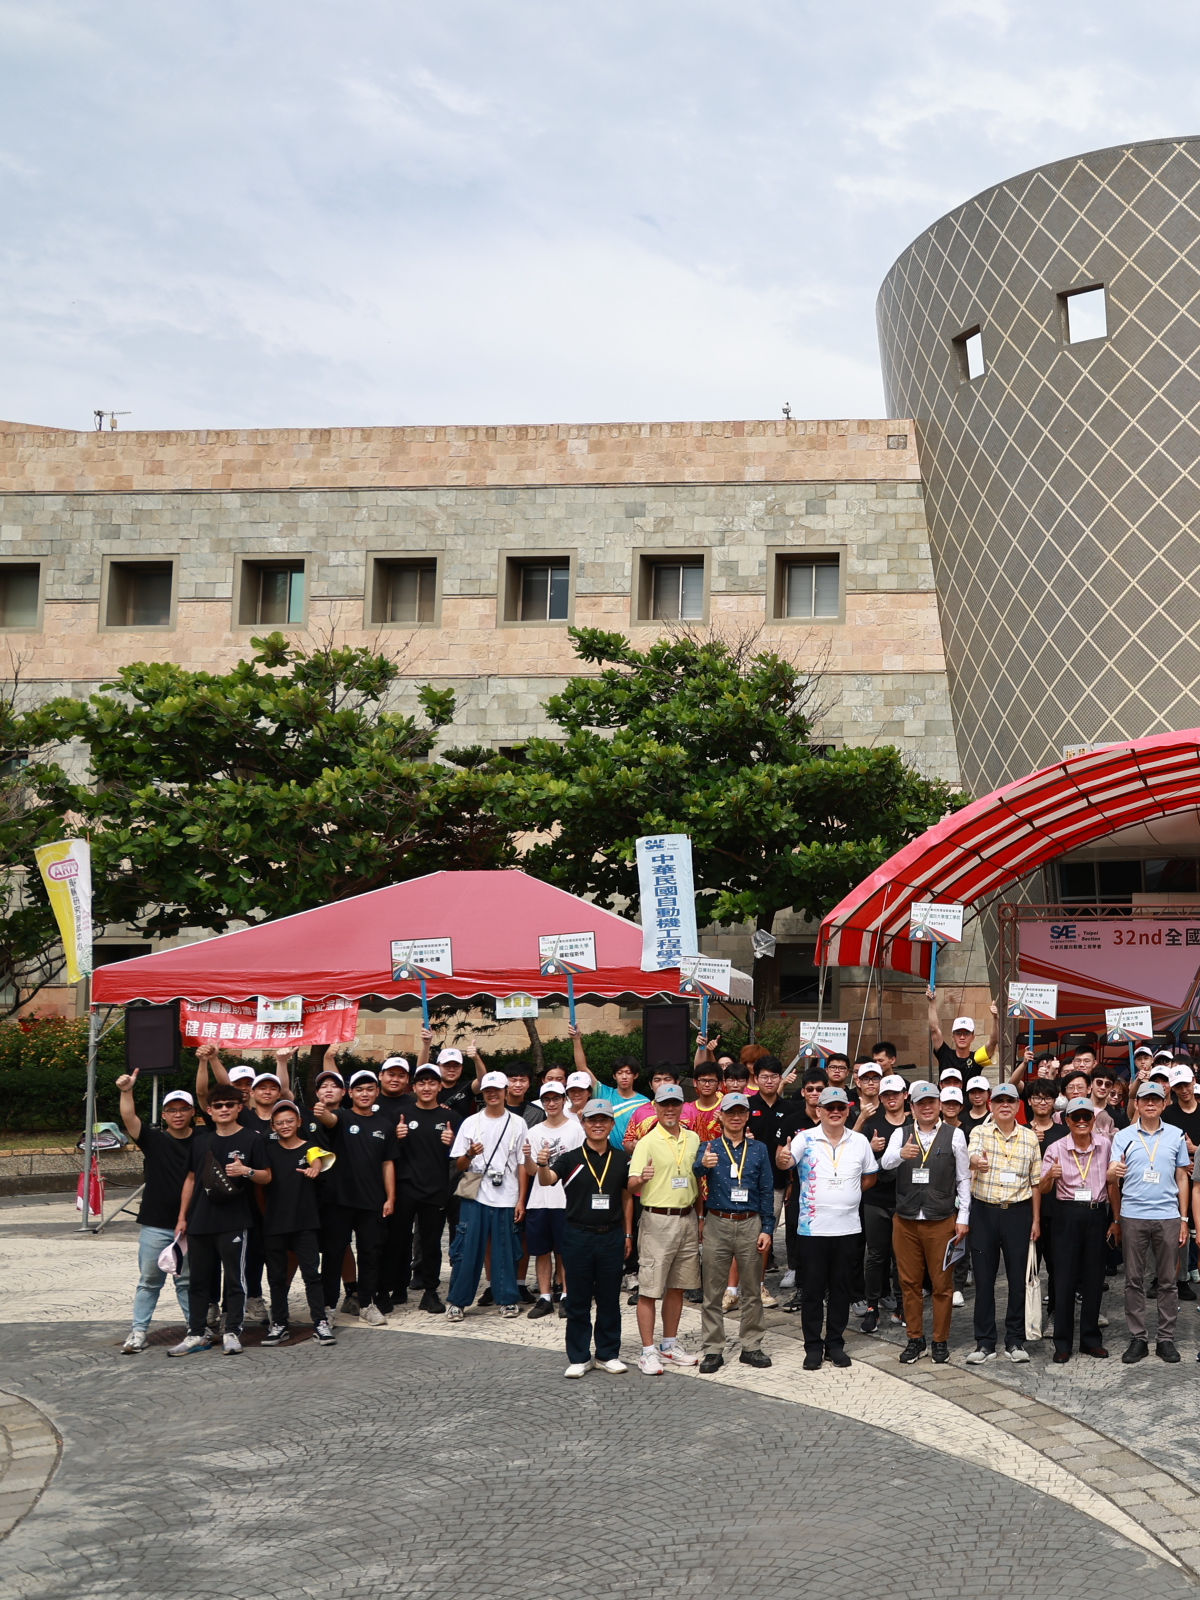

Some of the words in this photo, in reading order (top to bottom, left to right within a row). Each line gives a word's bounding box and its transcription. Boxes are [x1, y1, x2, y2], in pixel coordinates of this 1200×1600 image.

[645, 838, 665, 851] SAE
[651, 854, 683, 968] 中華民國自動機工程學會
[1050, 924, 1077, 939] SAE
[185, 1019, 304, 1040] 健康醫療服務站
[807, 1157, 821, 1218] MIRDC
